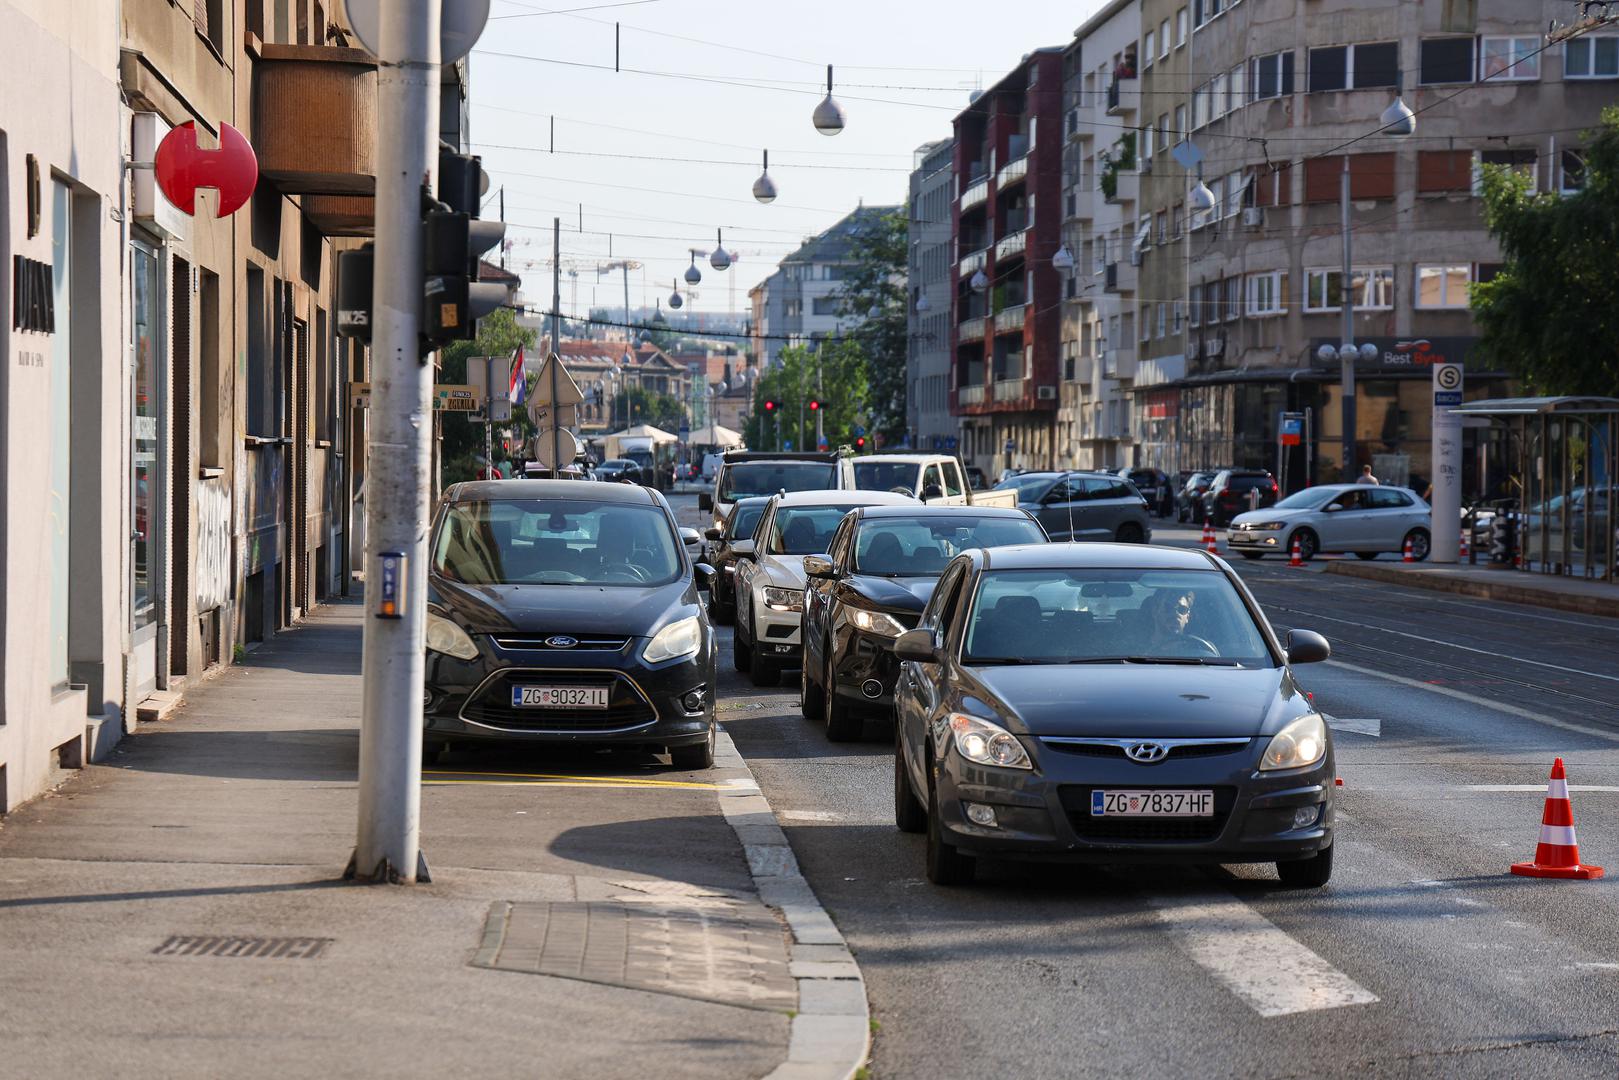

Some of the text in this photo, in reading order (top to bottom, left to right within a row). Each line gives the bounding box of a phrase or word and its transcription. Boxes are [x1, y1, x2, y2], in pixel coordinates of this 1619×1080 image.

[1384, 352, 1411, 364] Best
[1444, 370, 1455, 385] S
[523, 689, 541, 704] ZG
[1105, 793, 1128, 813] ZG
